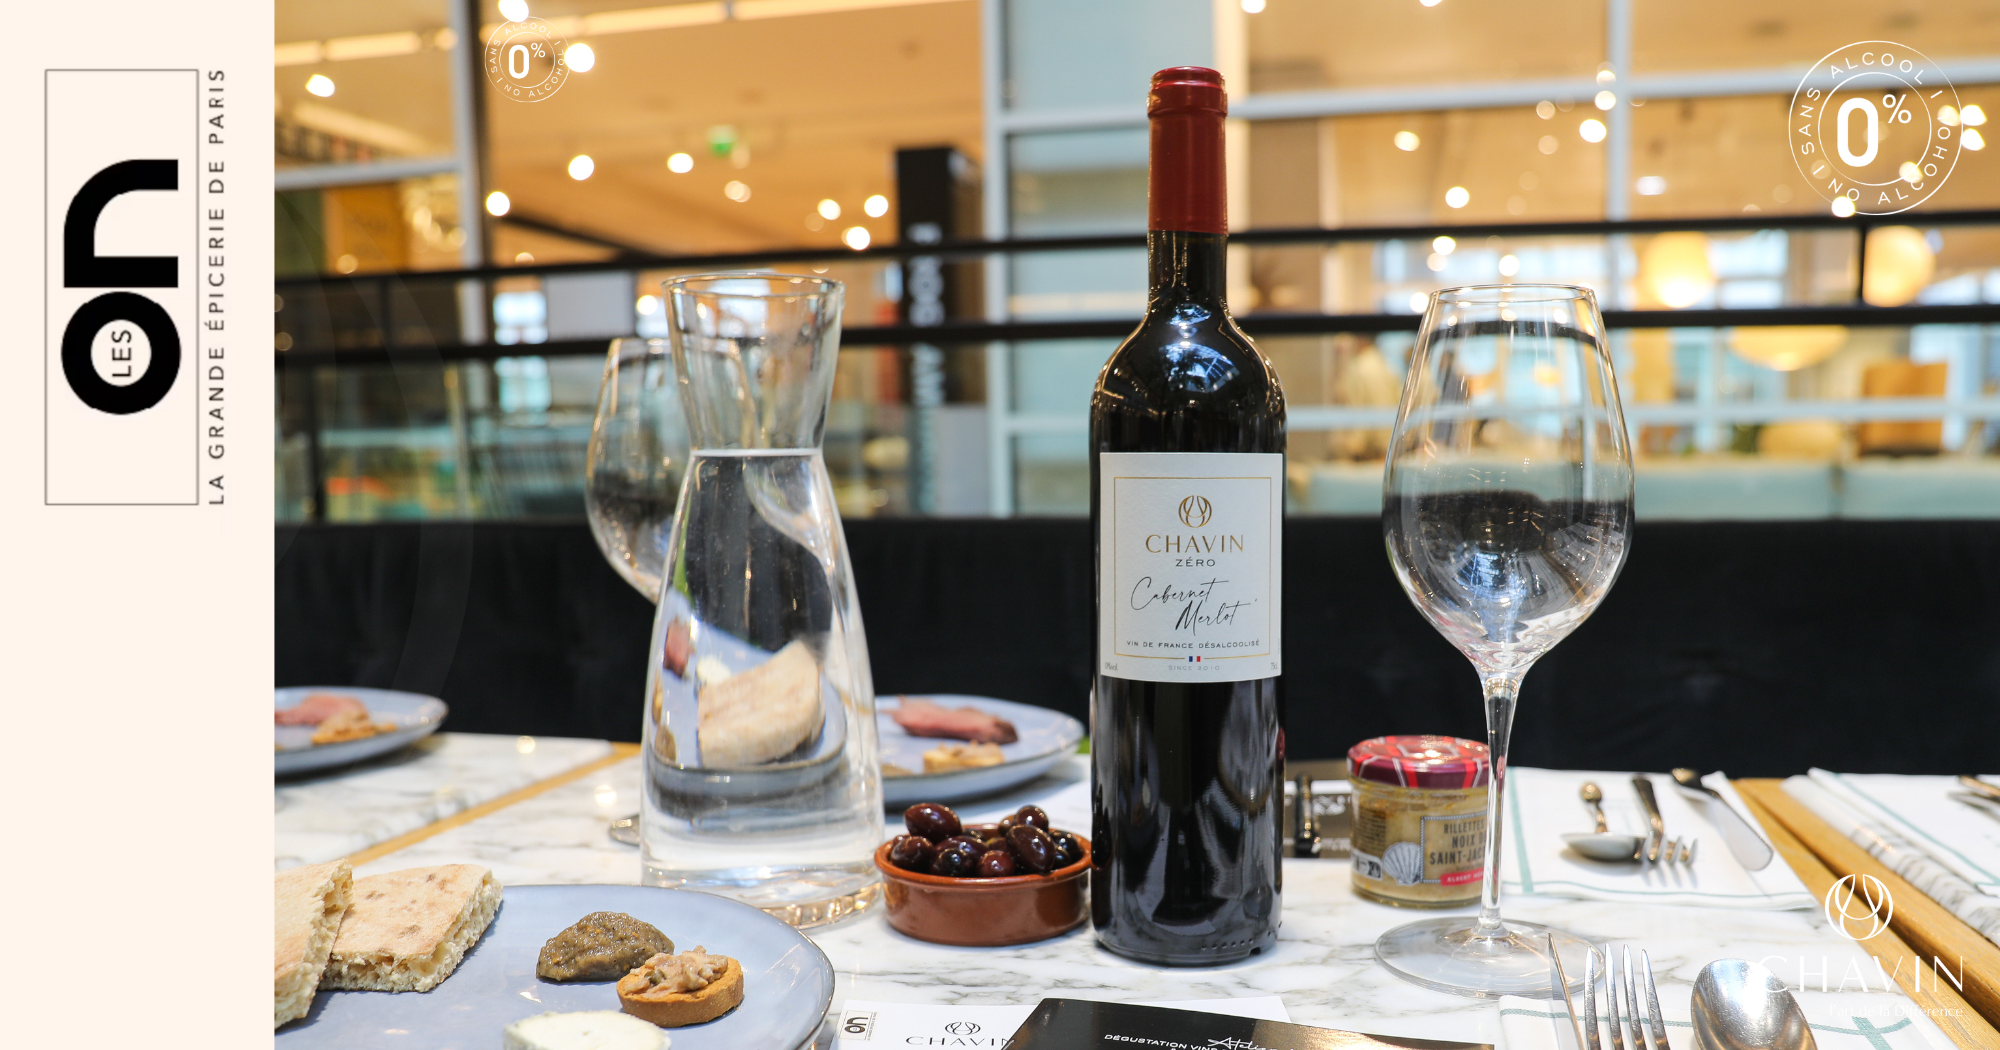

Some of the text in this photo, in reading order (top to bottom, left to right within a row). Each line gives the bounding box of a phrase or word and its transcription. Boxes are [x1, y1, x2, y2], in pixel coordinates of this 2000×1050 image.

[1145, 534, 1244, 553] CHAVIN
[1175, 556, 1216, 567] ZÉRO
[1130, 576, 1230, 610] Cabernet
[1174, 600, 1252, 636] Merlot
[1198, 639, 1260, 649] DÉSALCOOLISÉ
[1444, 819, 1485, 834] RILLETTES
[1452, 834, 1475, 848] NOIX
[1430, 845, 1486, 865] SAINT-JAC
[1104, 1034, 1187, 1049] DÉGUSTATION
